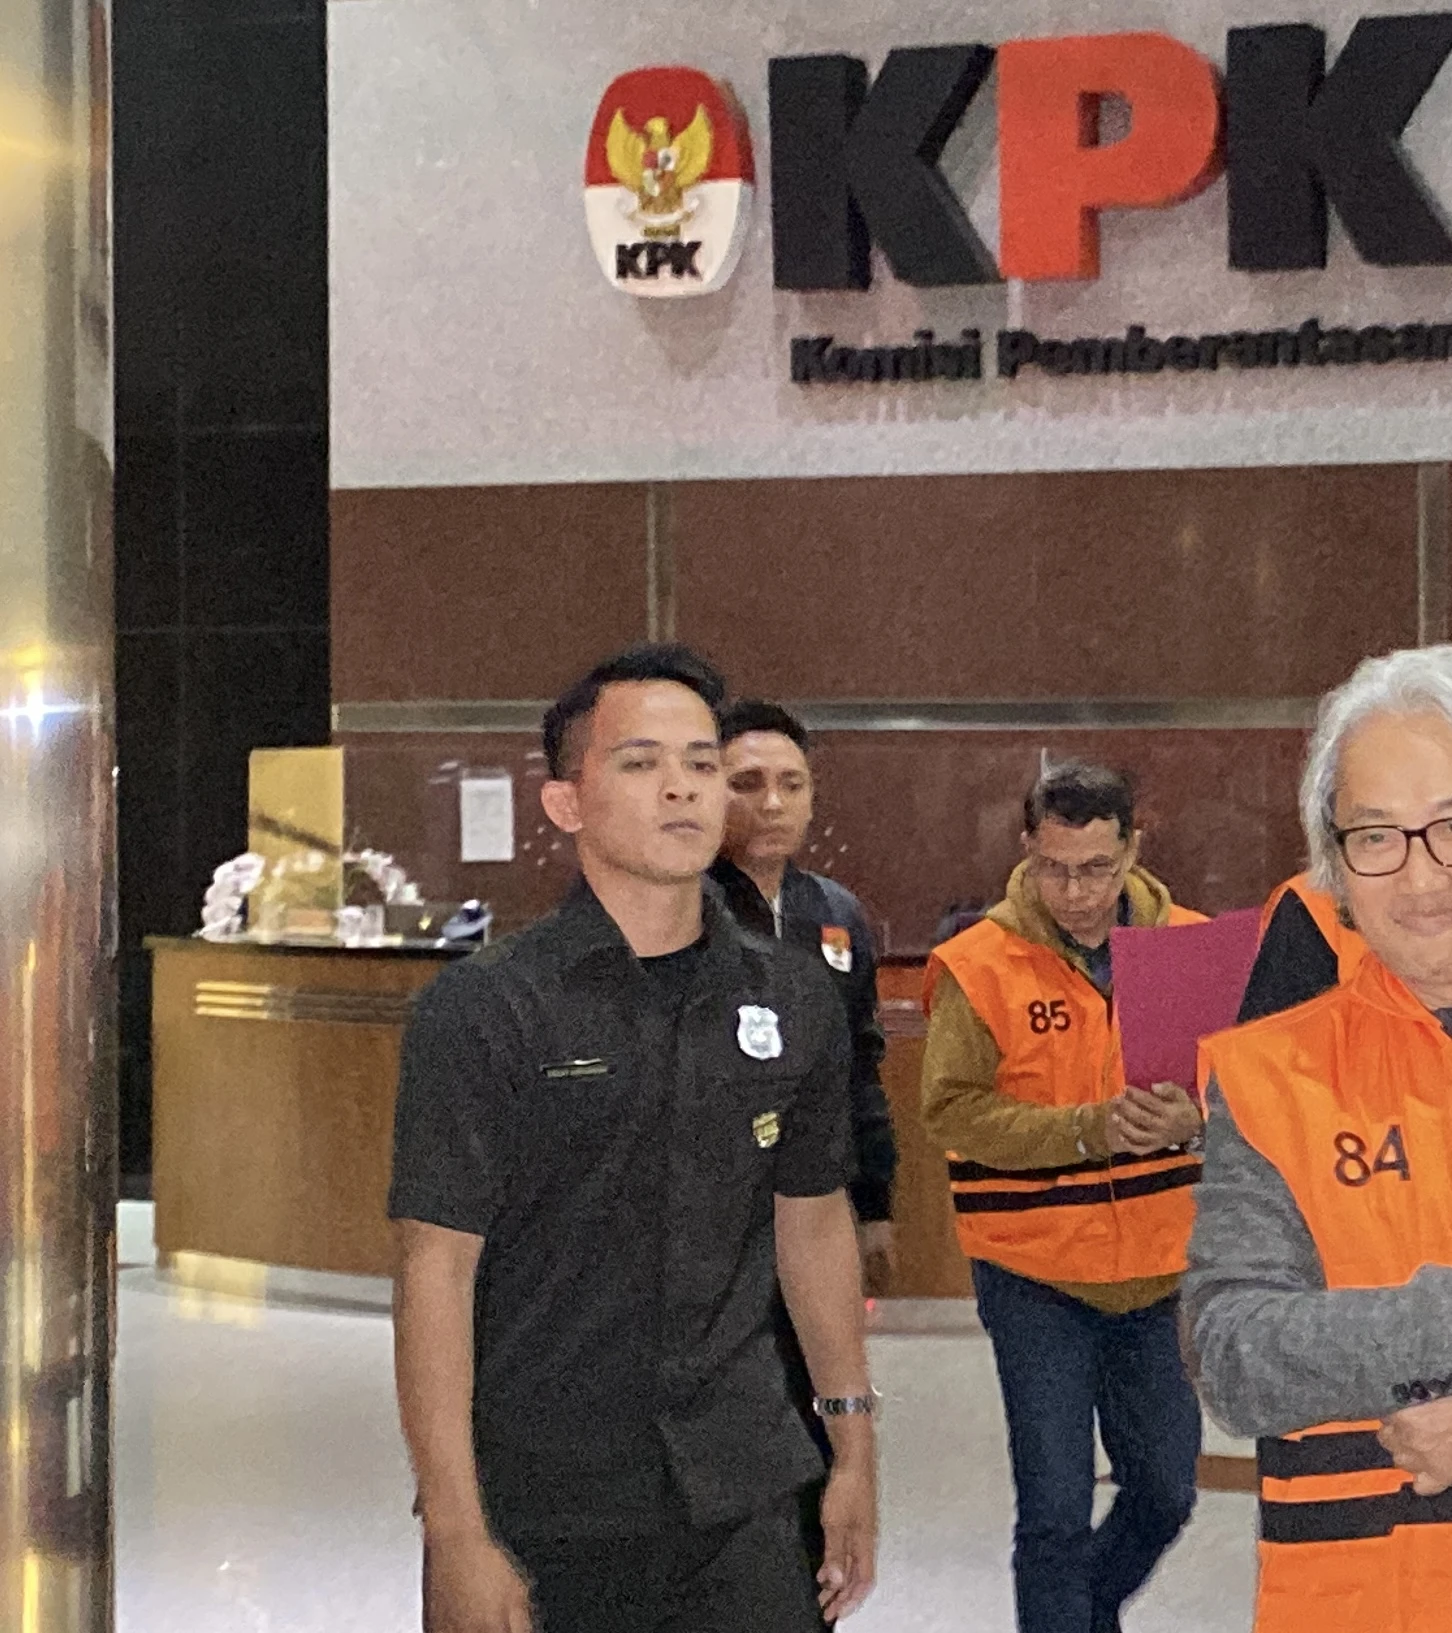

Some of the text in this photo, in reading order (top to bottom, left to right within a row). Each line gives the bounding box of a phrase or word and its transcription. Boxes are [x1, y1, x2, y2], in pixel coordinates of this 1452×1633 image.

[616, 241, 702, 279] KPK
[791, 328, 982, 382] Komisi
[1028, 1000, 1071, 1034] 85
[1333, 1124, 1411, 1188] 84
